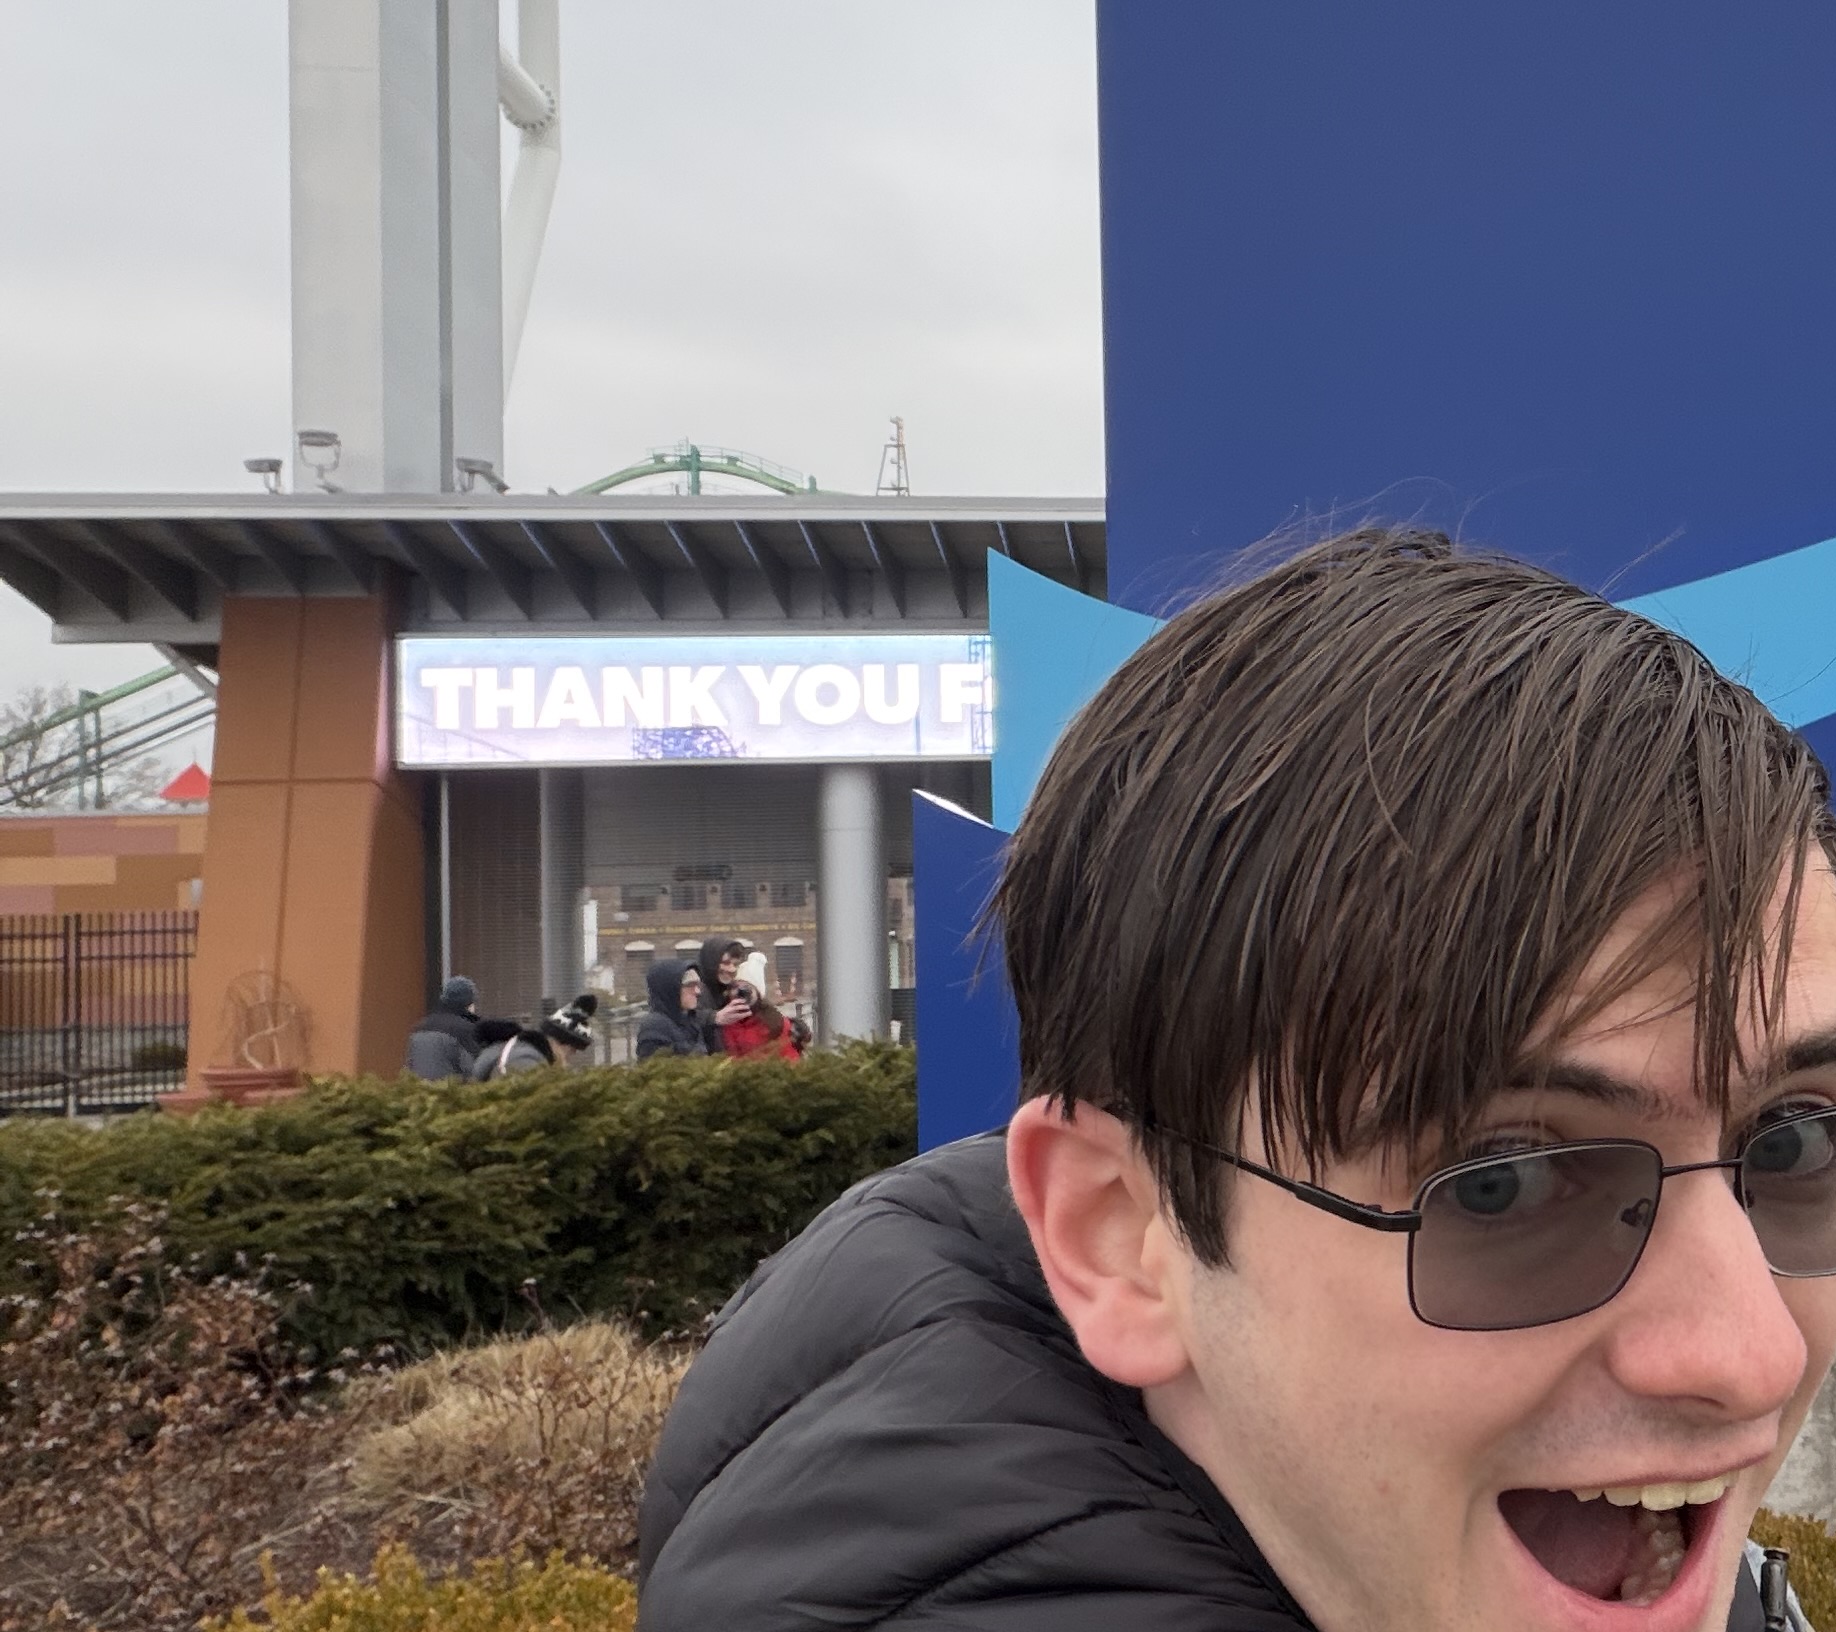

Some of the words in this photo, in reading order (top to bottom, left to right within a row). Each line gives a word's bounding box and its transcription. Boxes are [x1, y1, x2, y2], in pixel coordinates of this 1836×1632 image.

[420, 666, 729, 729] THANK
[737, 663, 920, 726] YOU
[939, 663, 992, 723] F
